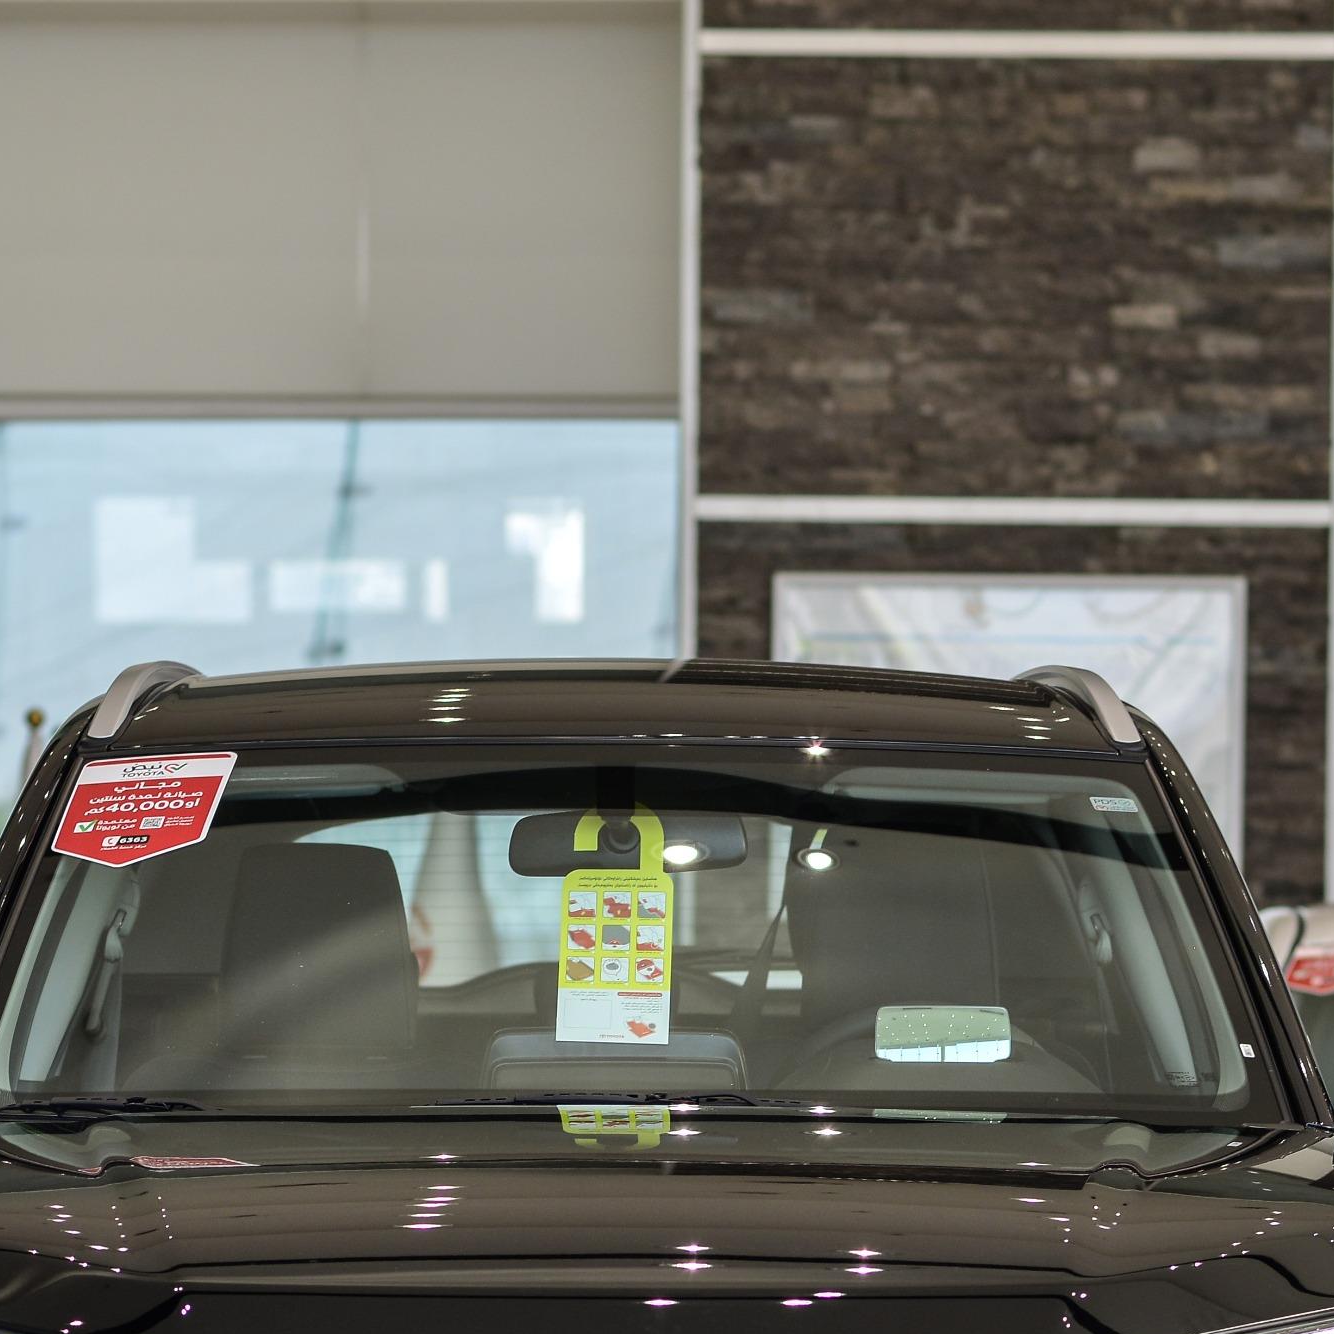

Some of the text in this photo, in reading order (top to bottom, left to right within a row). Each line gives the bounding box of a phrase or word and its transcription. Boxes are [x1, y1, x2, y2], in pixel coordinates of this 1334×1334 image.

[123, 761, 163, 773] نبض
[89, 791, 204, 804] صيانة لمدة سنتين
[84, 806, 105, 816] كم
[105, 800, 184, 812] 40,000
[119, 836, 148, 844] 6363
